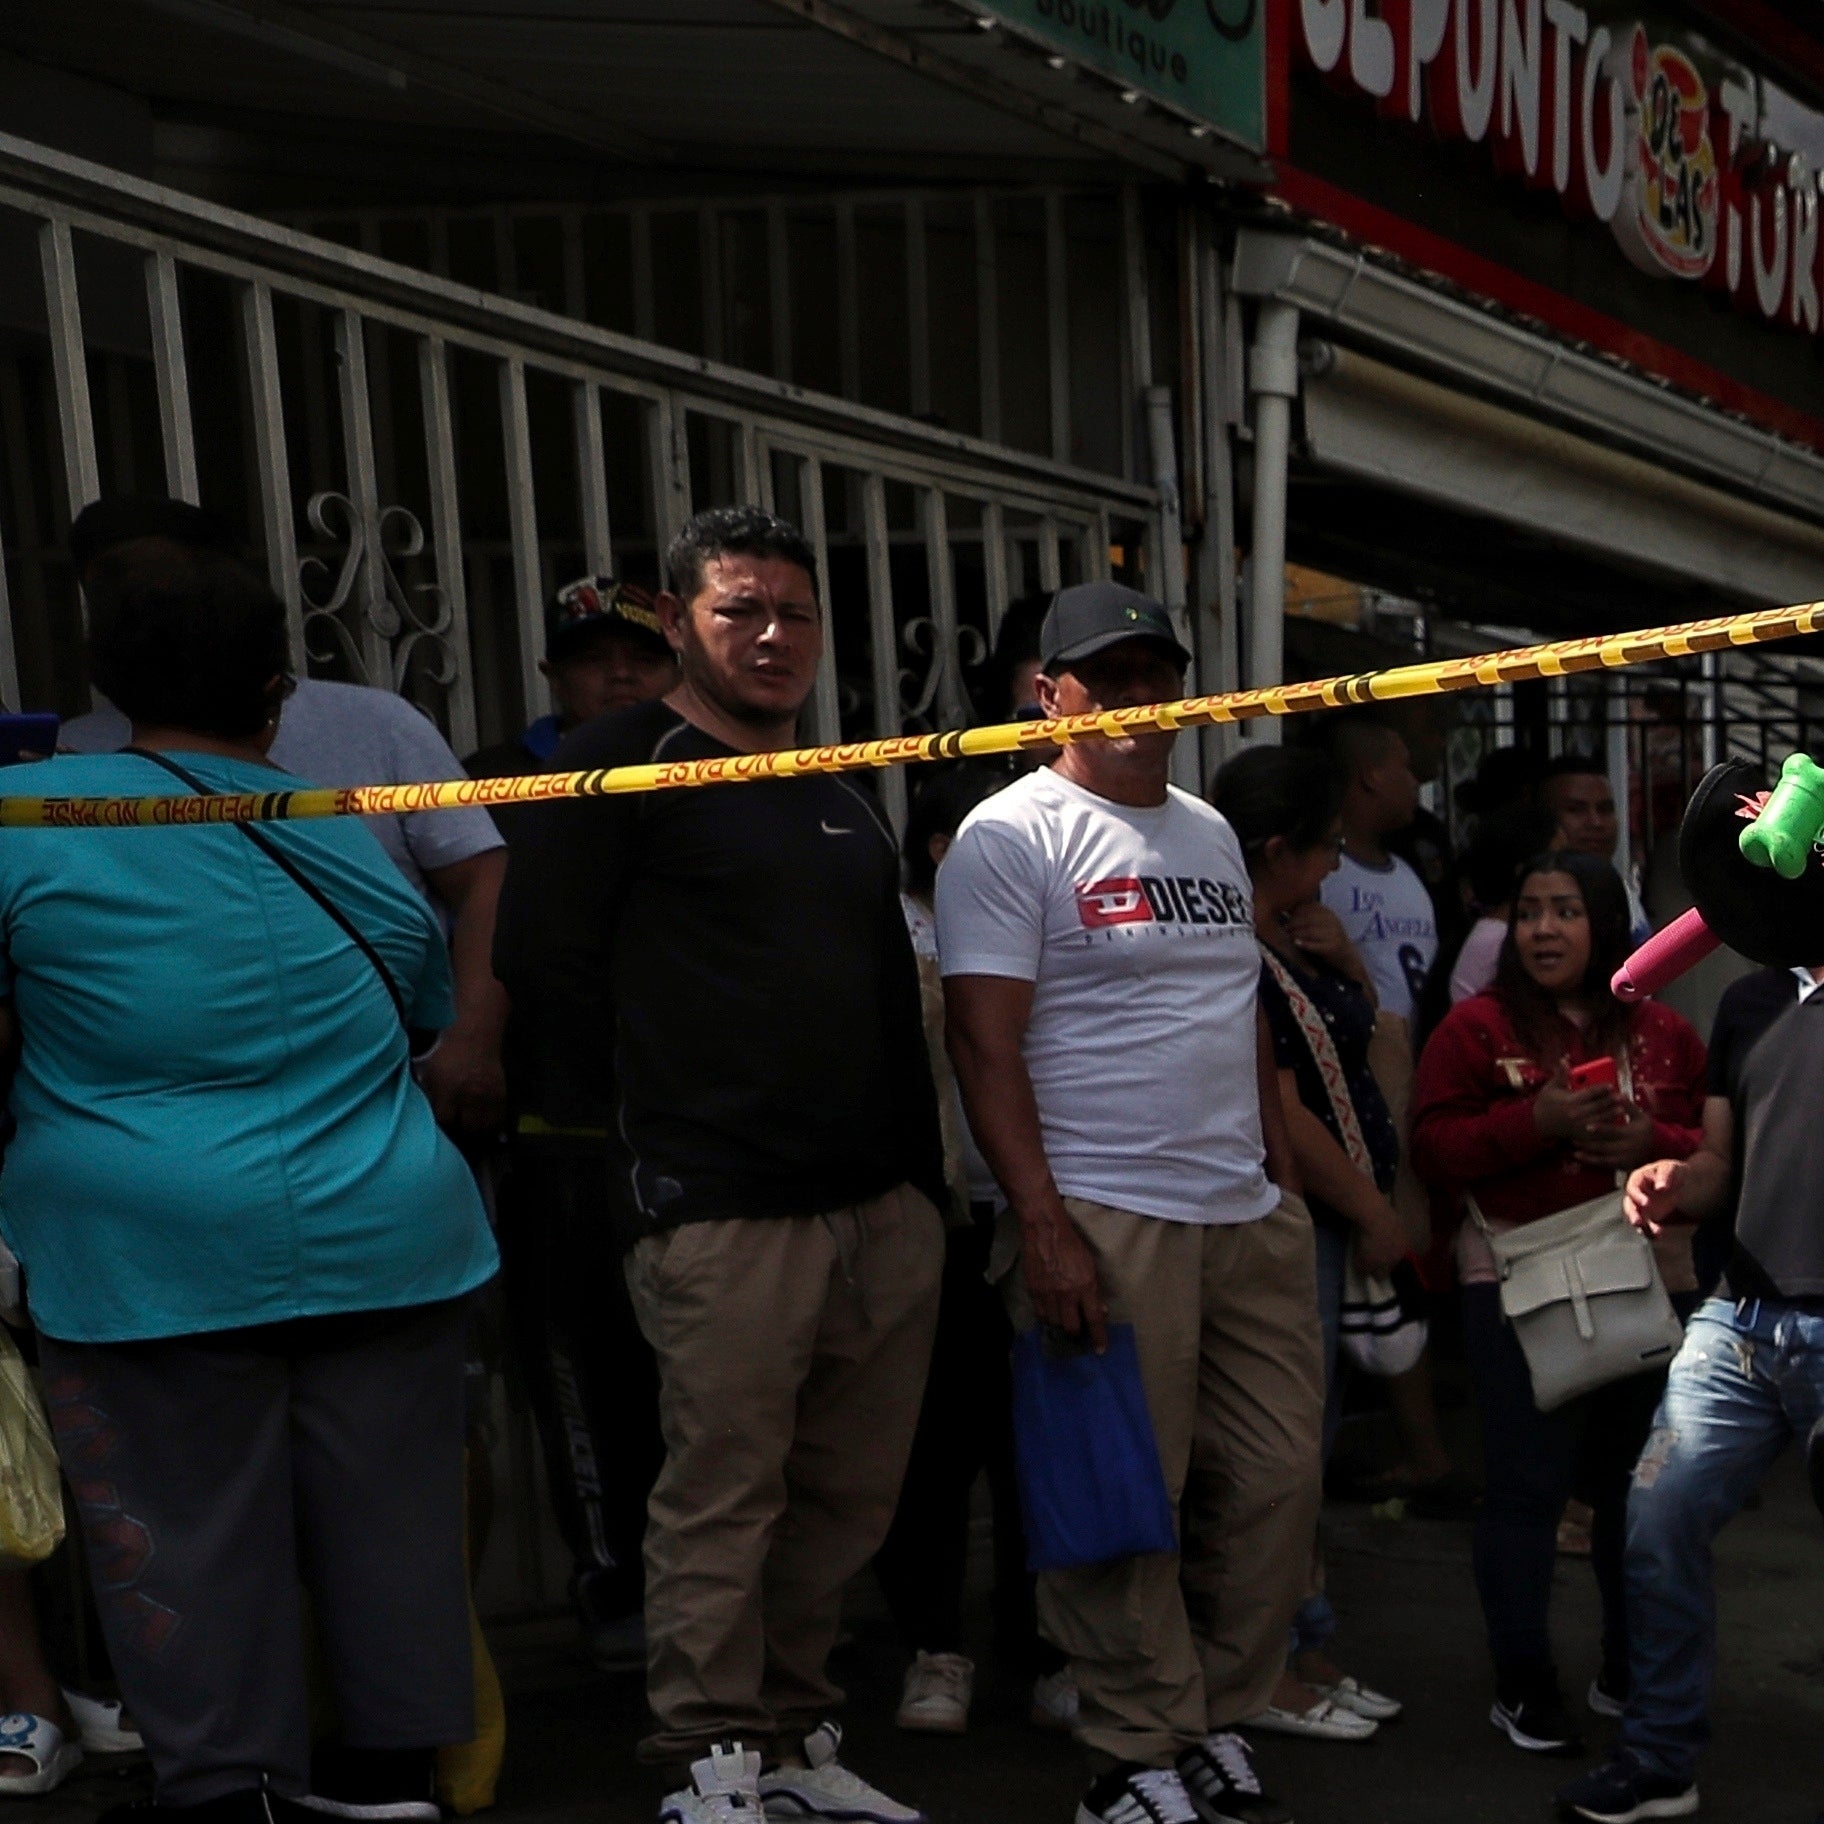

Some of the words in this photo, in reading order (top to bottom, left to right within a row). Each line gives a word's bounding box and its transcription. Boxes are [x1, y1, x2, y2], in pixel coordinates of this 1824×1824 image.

[1408, 0, 1627, 221] PUNTO
[1660, 165, 1703, 251] LAS
[335, 787, 396, 815] PASE
[404, 782, 441, 810] NO
[457, 771, 574, 804] PELIGRO
[42, 800, 100, 827] PASE
[104, 799, 140, 826] NO
[152, 795, 258, 824] PELIGRO
